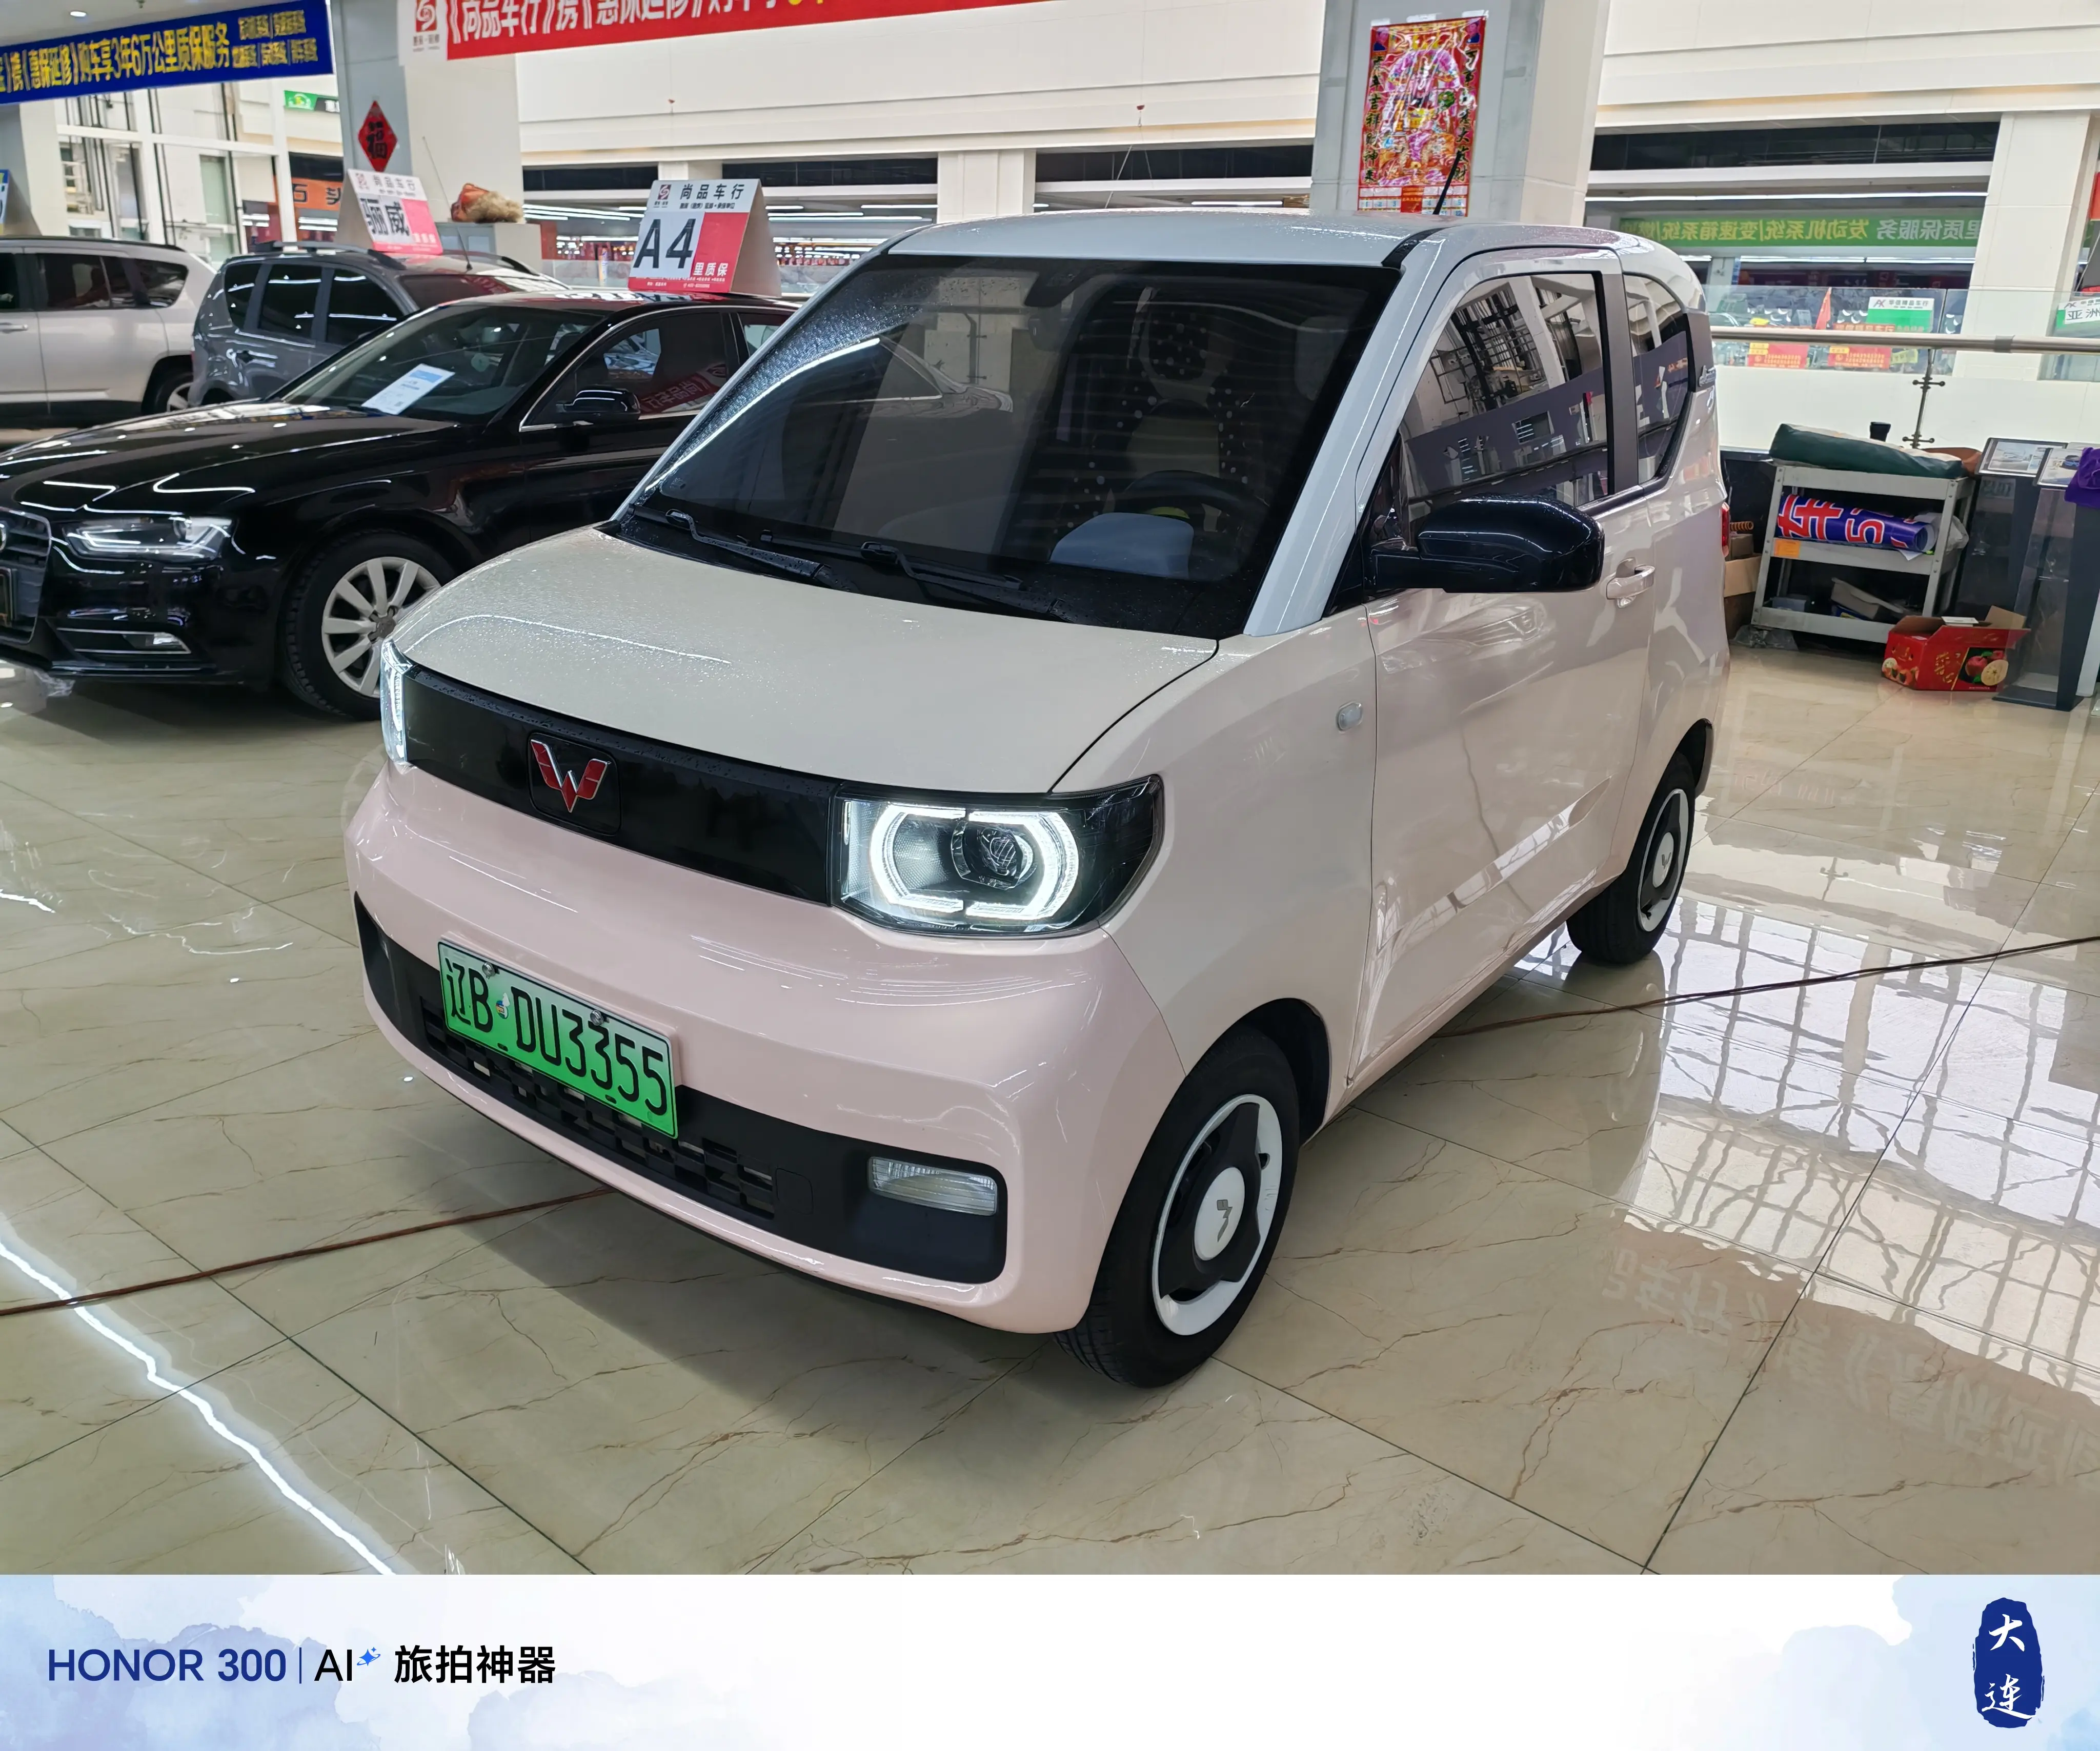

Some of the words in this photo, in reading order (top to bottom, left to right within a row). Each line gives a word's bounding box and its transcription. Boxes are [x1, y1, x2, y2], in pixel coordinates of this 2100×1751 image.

[680, 184, 744, 199] 尚品车行
[633, 218, 696, 269] A4
[693, 262, 729, 276] 里质保
[510, 985, 668, 1116] DU3355
